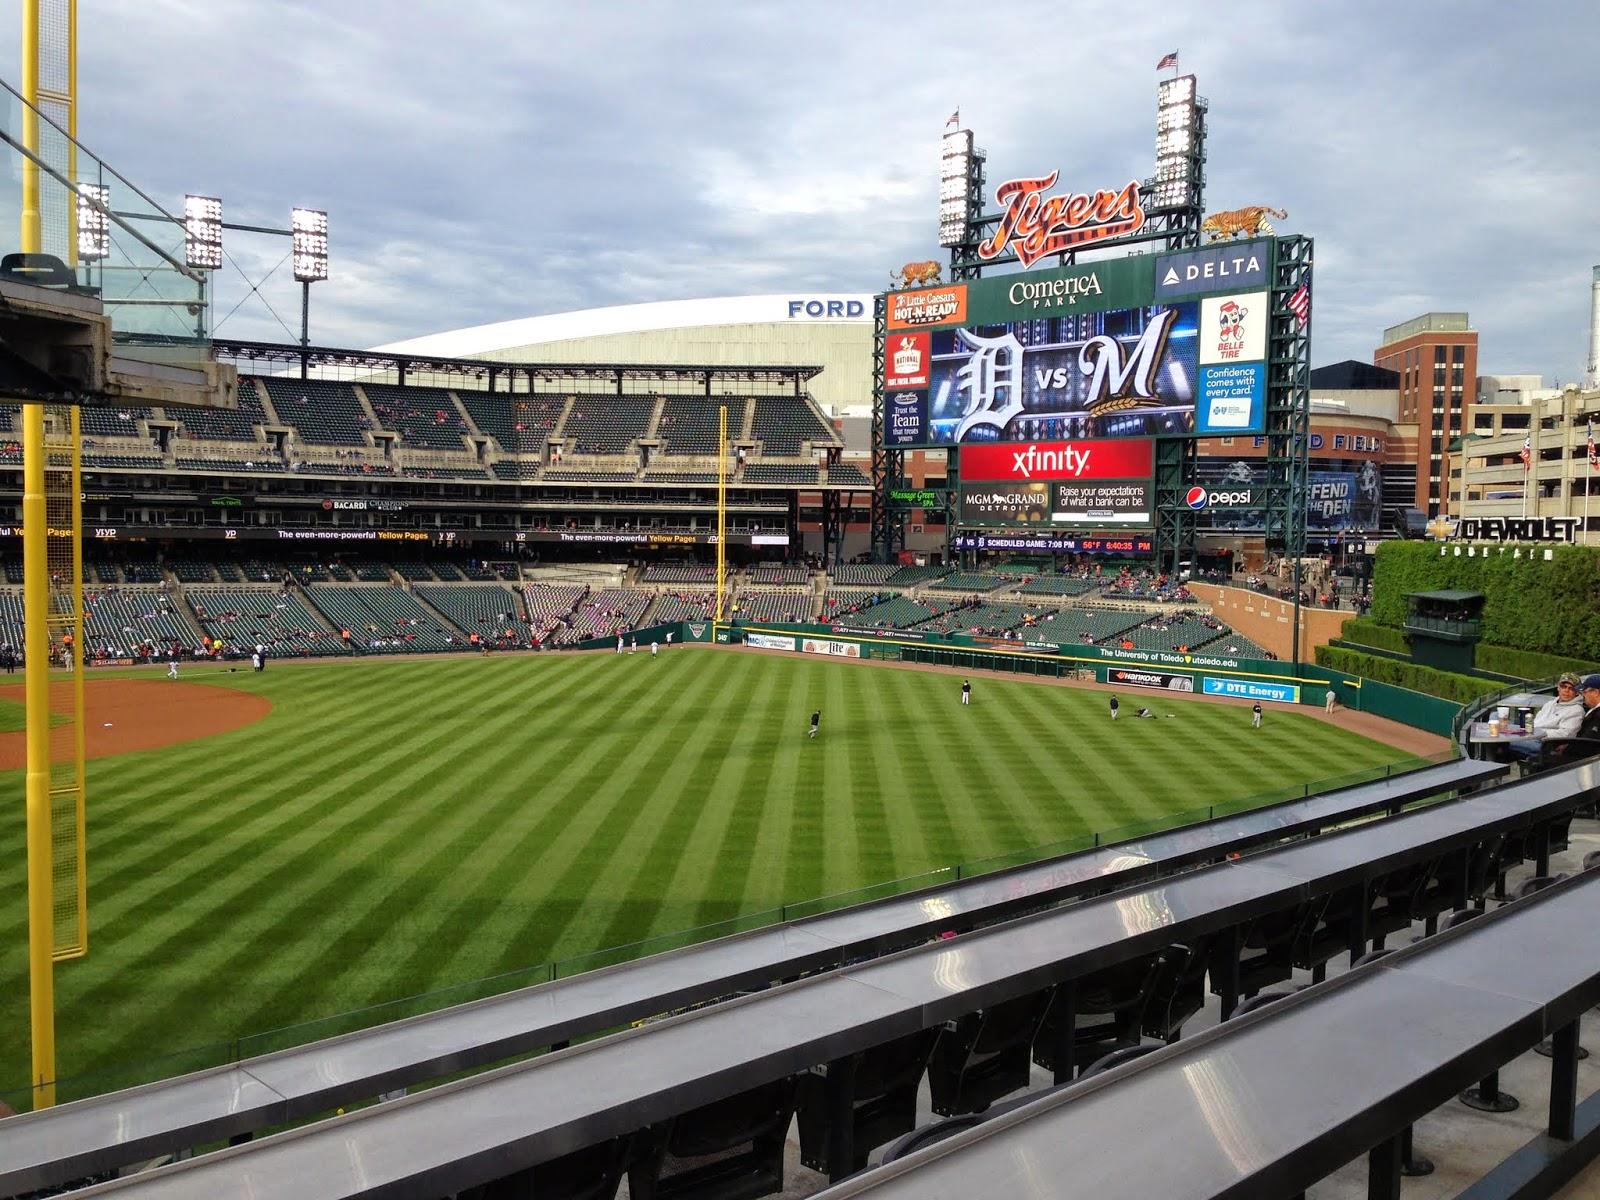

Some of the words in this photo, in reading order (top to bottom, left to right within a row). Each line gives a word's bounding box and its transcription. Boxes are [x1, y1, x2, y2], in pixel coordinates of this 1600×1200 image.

[978, 169, 1145, 269] Tigers
[1186, 256, 1260, 281] DELTA
[907, 295, 926, 306] Little
[927, 292, 956, 304] Caesars
[1033, 295, 1076, 308] PARK
[788, 300, 864, 318] FORD
[894, 301, 959, 320] HOT-N-READY
[1217, 341, 1244, 351] BELLE
[1220, 350, 1240, 359] TIRE
[1206, 368, 1255, 378] Confidence
[1206, 379, 1234, 387] comes
[1236, 376, 1255, 385] with
[1206, 388, 1229, 397] every
[892, 413, 920, 427] Team
[1252, 433, 1324, 450] FD
[1332, 433, 1381, 453] FIELD
[1012, 444, 1091, 477] xfinity
[1060, 486, 1079, 496] Raise
[1080, 488, 1097, 498] your
[1098, 486, 1144, 498] expectations
[1208, 489, 1251, 506] pepsi
[1307, 483, 1348, 499] FEND
[966, 494, 993, 504] MGM
[1007, 493, 1045, 504] GRAND
[1061, 498, 1070, 506] of
[1070, 497, 1087, 506] what
[1095, 498, 1113, 506] bank
[1308, 500, 1323, 511] HE
[1323, 499, 1351, 518] DEN
[47, 528, 75, 537] Page
[278, 531, 294, 539] The
[295, 531, 376, 540] even-more-powerful
[378, 531, 403, 539] Yellow
[404, 531, 429, 540] Pages
[1462, 517, 1582, 544] CHEVROLET
[561, 533, 574, 541] The
[575, 533, 647, 542] even-more-powerful
[649, 534, 673, 542] Yellow
[674, 534, 697, 543] Pages
[987, 539, 1025, 548] SCHEDULED
[1025, 539, 1046, 548] GAME:
[1063, 540, 1075, 549] PM
[1105, 541, 1133, 550] 6:40:35
[1138, 542, 1151, 550] PM
[1100, 648, 1113, 657] The
[1115, 649, 1149, 662] University
[1160, 653, 1184, 663] Toledo
[1192, 656, 1238, 668] utoledo.edu
[1227, 683, 1247, 693] DTE
[1249, 685, 1286, 699] Energy
